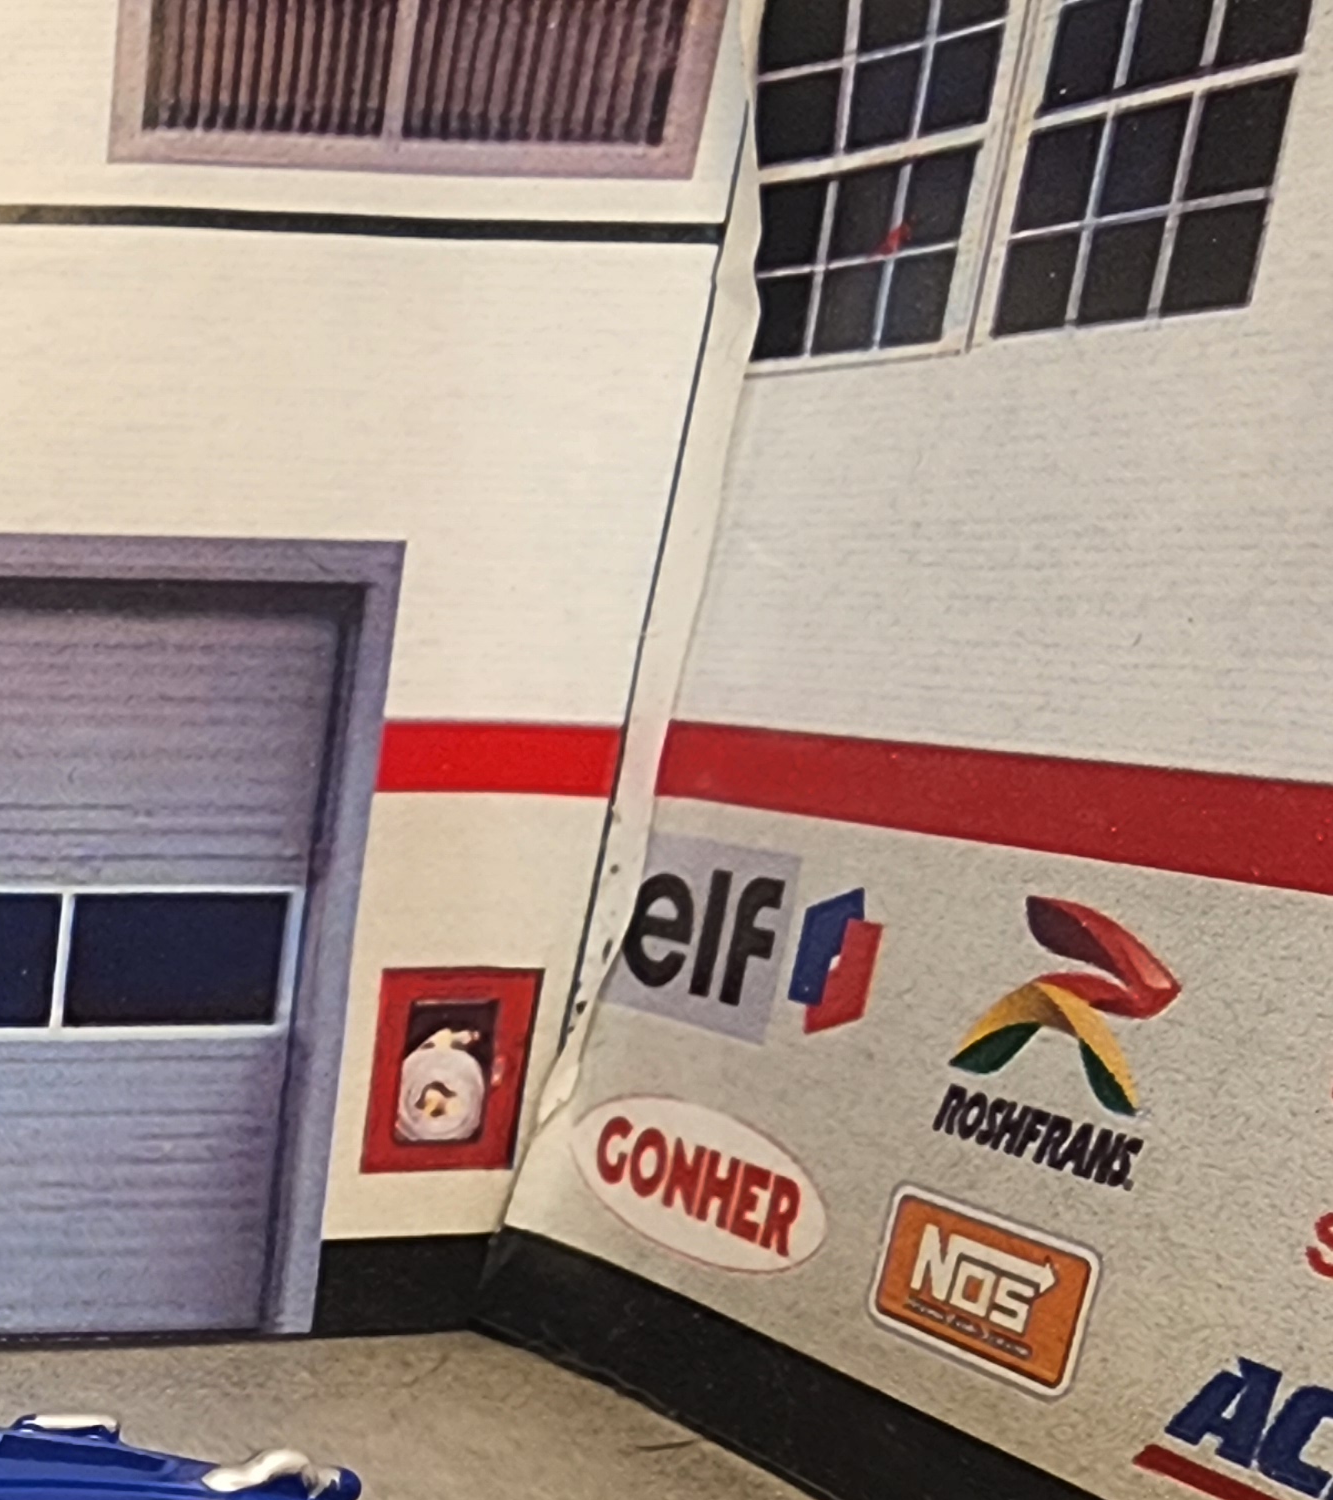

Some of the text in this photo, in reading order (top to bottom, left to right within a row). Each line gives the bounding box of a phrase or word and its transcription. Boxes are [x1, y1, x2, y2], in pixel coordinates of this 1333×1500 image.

[623, 869, 786, 1006] elf
[597, 1116, 801, 1257] GONHER
[933, 1083, 1144, 1191] ROSHFRANS
[910, 1223, 1056, 1333] NOS
